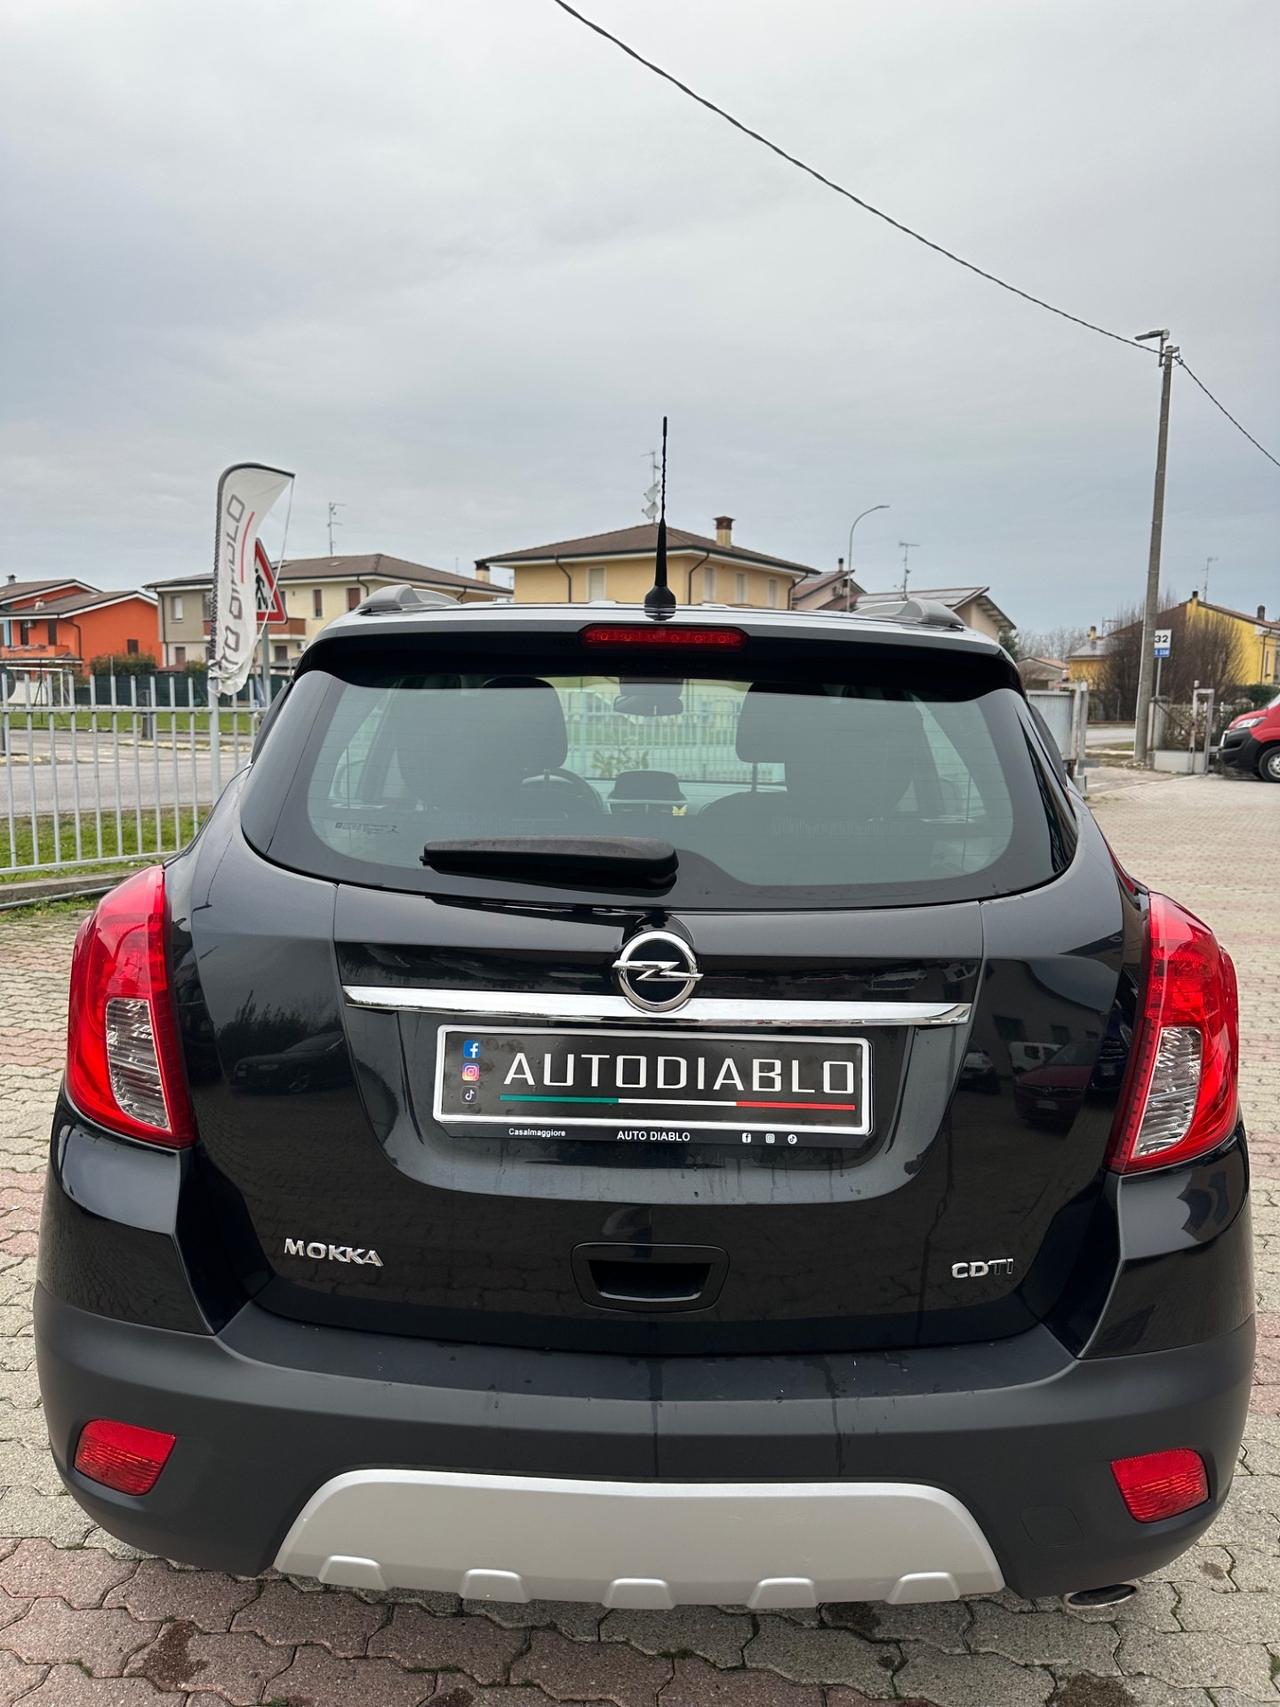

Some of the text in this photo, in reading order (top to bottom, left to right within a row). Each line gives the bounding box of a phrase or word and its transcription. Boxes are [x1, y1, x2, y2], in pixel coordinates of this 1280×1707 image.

[1154, 634, 1168, 643] 32
[503, 1052, 855, 1095] AUTODIABLO
[508, 1127, 567, 1138] Casalmaggiore
[616, 1130, 691, 1142] AUTO DIABLO
[283, 1237, 384, 1267] MOKKA
